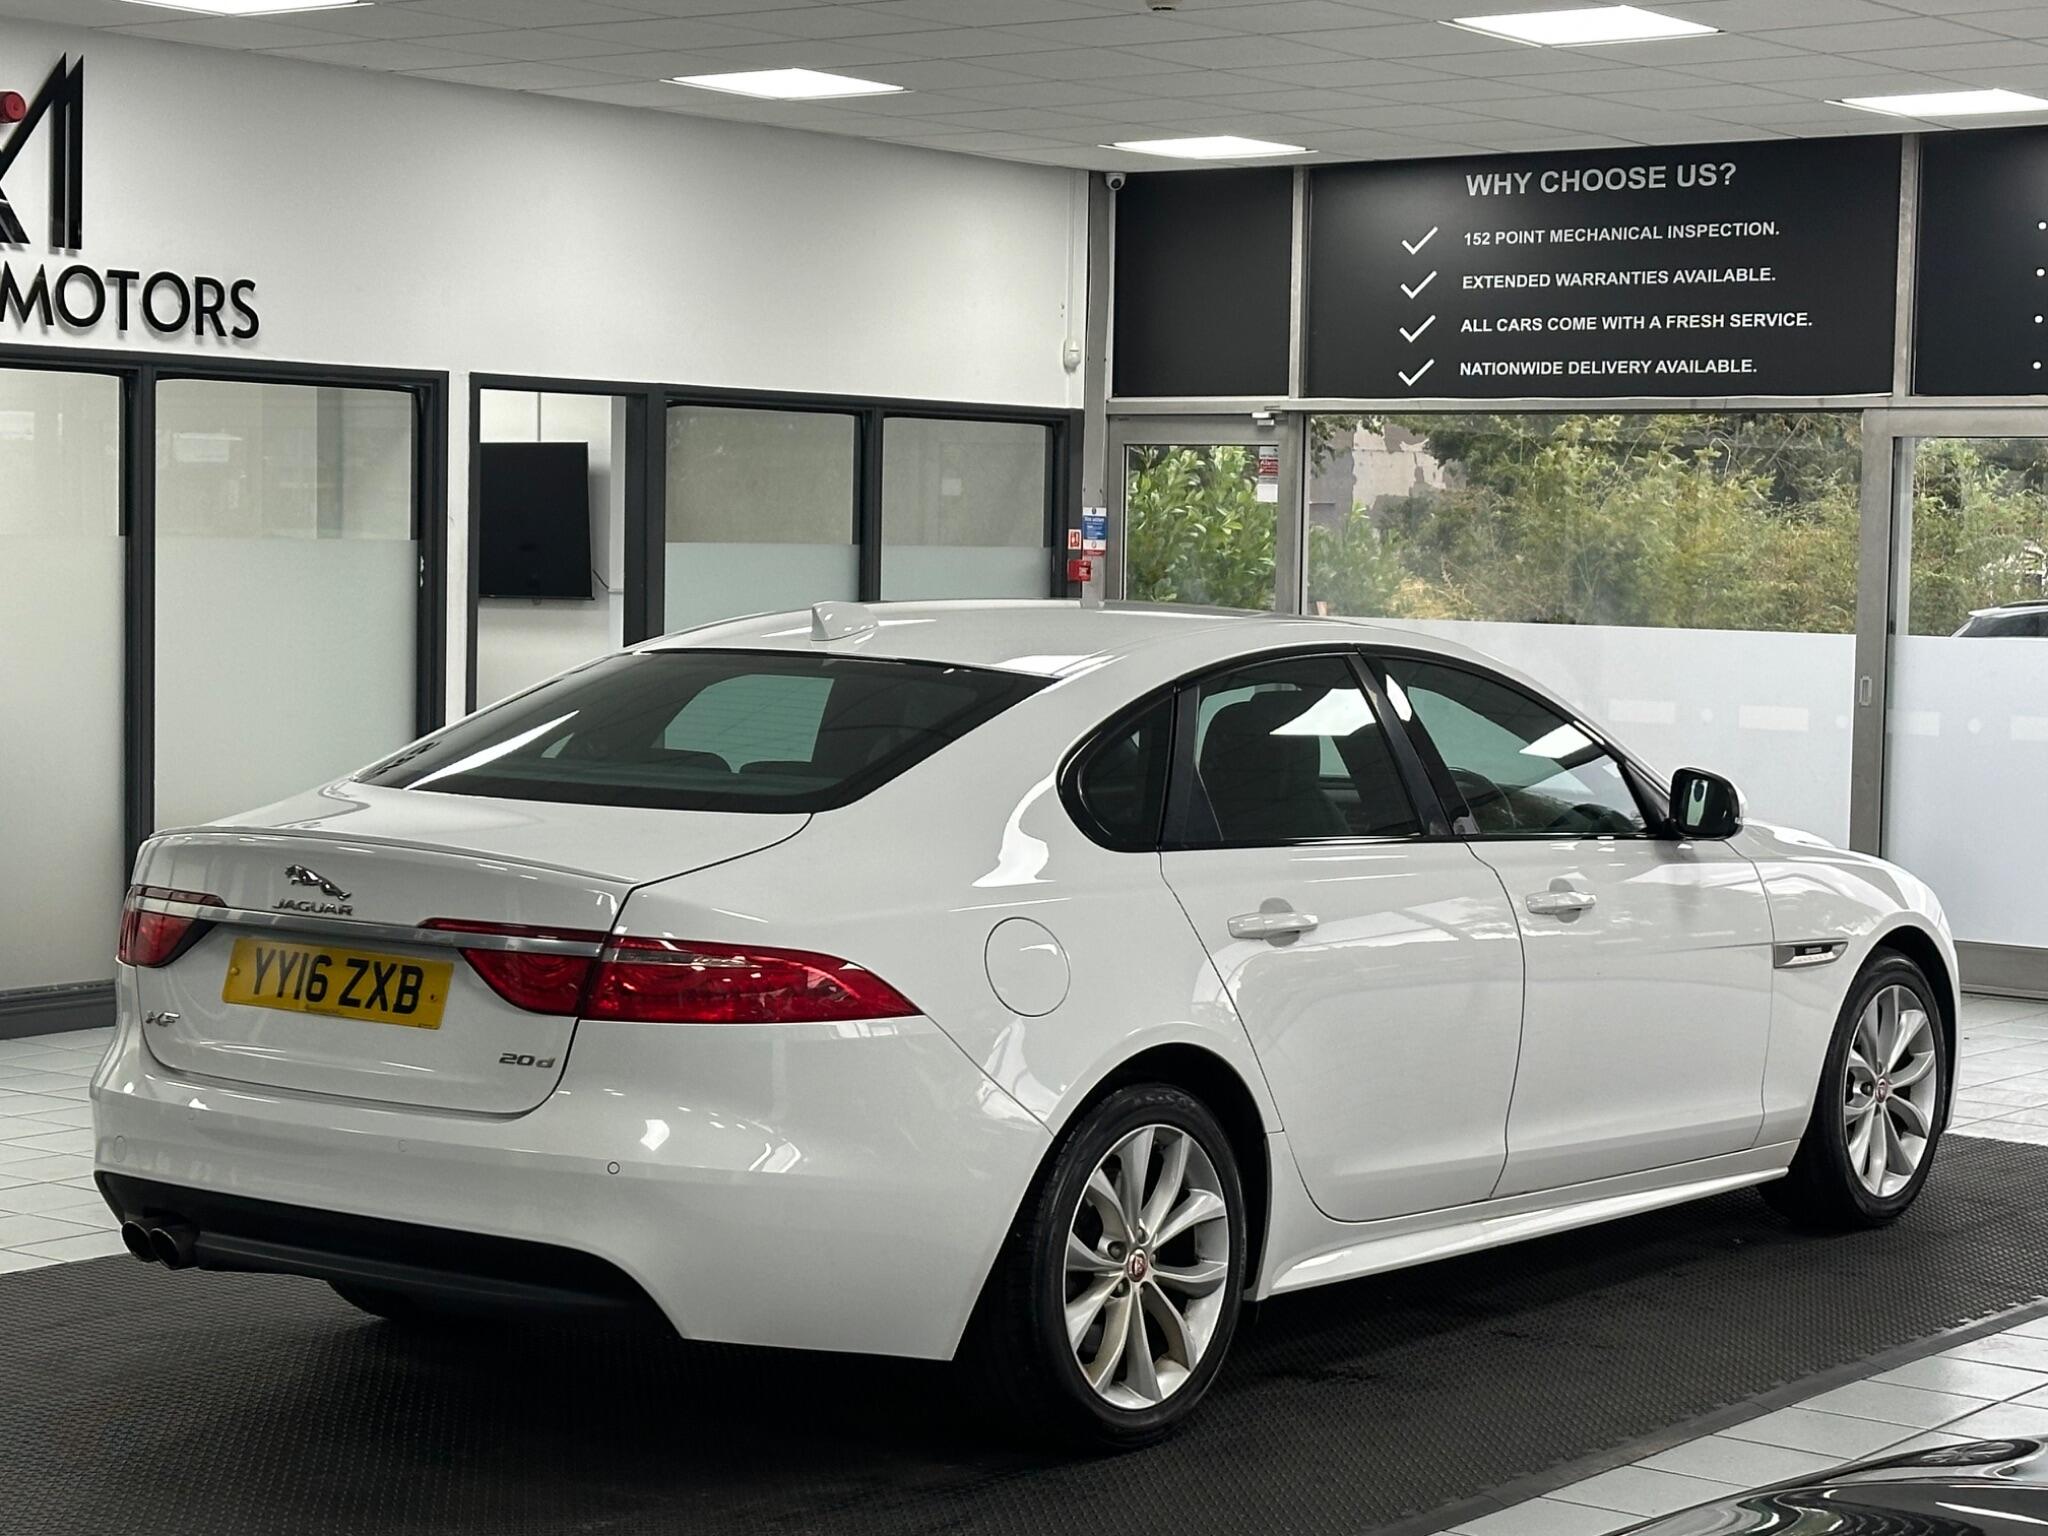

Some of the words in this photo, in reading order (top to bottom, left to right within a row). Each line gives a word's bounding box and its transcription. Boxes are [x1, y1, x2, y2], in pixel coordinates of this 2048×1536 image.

[1465, 171, 1533, 198] WHY
[1539, 165, 1667, 194] CHOOSE
[1675, 162, 1737, 188] US?
[1463, 231, 1491, 247] 152
[1494, 229, 1546, 246] POINT
[1549, 225, 1663, 243] MECHANICAL
[1667, 220, 1780, 240] INSPECTION.
[1462, 273, 1551, 290] EXTENDED
[1555, 269, 1669, 287] WARRANTIES
[1672, 267, 1776, 284] AVAILABLE.
[0, 260, 259, 339] MOTORS
[1460, 318, 1494, 334] ALL
[1496, 317, 1543, 333] CARS
[1546, 316, 1598, 332] COME
[1601, 315, 1646, 331] WITH
[1648, 315, 1663, 330] A
[1665, 313, 1725, 329] FRESH
[1729, 311, 1813, 328] SERVICE.
[1460, 360, 1564, 377] NATIONWIDE
[1567, 359, 1652, 375] DELIVERY
[1655, 358, 1758, 375] AVAILABLE.
[272, 898, 354, 916] JAGUAR
[252, 946, 332, 1002] YY16
[338, 957, 425, 1015] ZXB
[144, 1009, 181, 1028] XF
[498, 1051, 556, 1069] 20d
